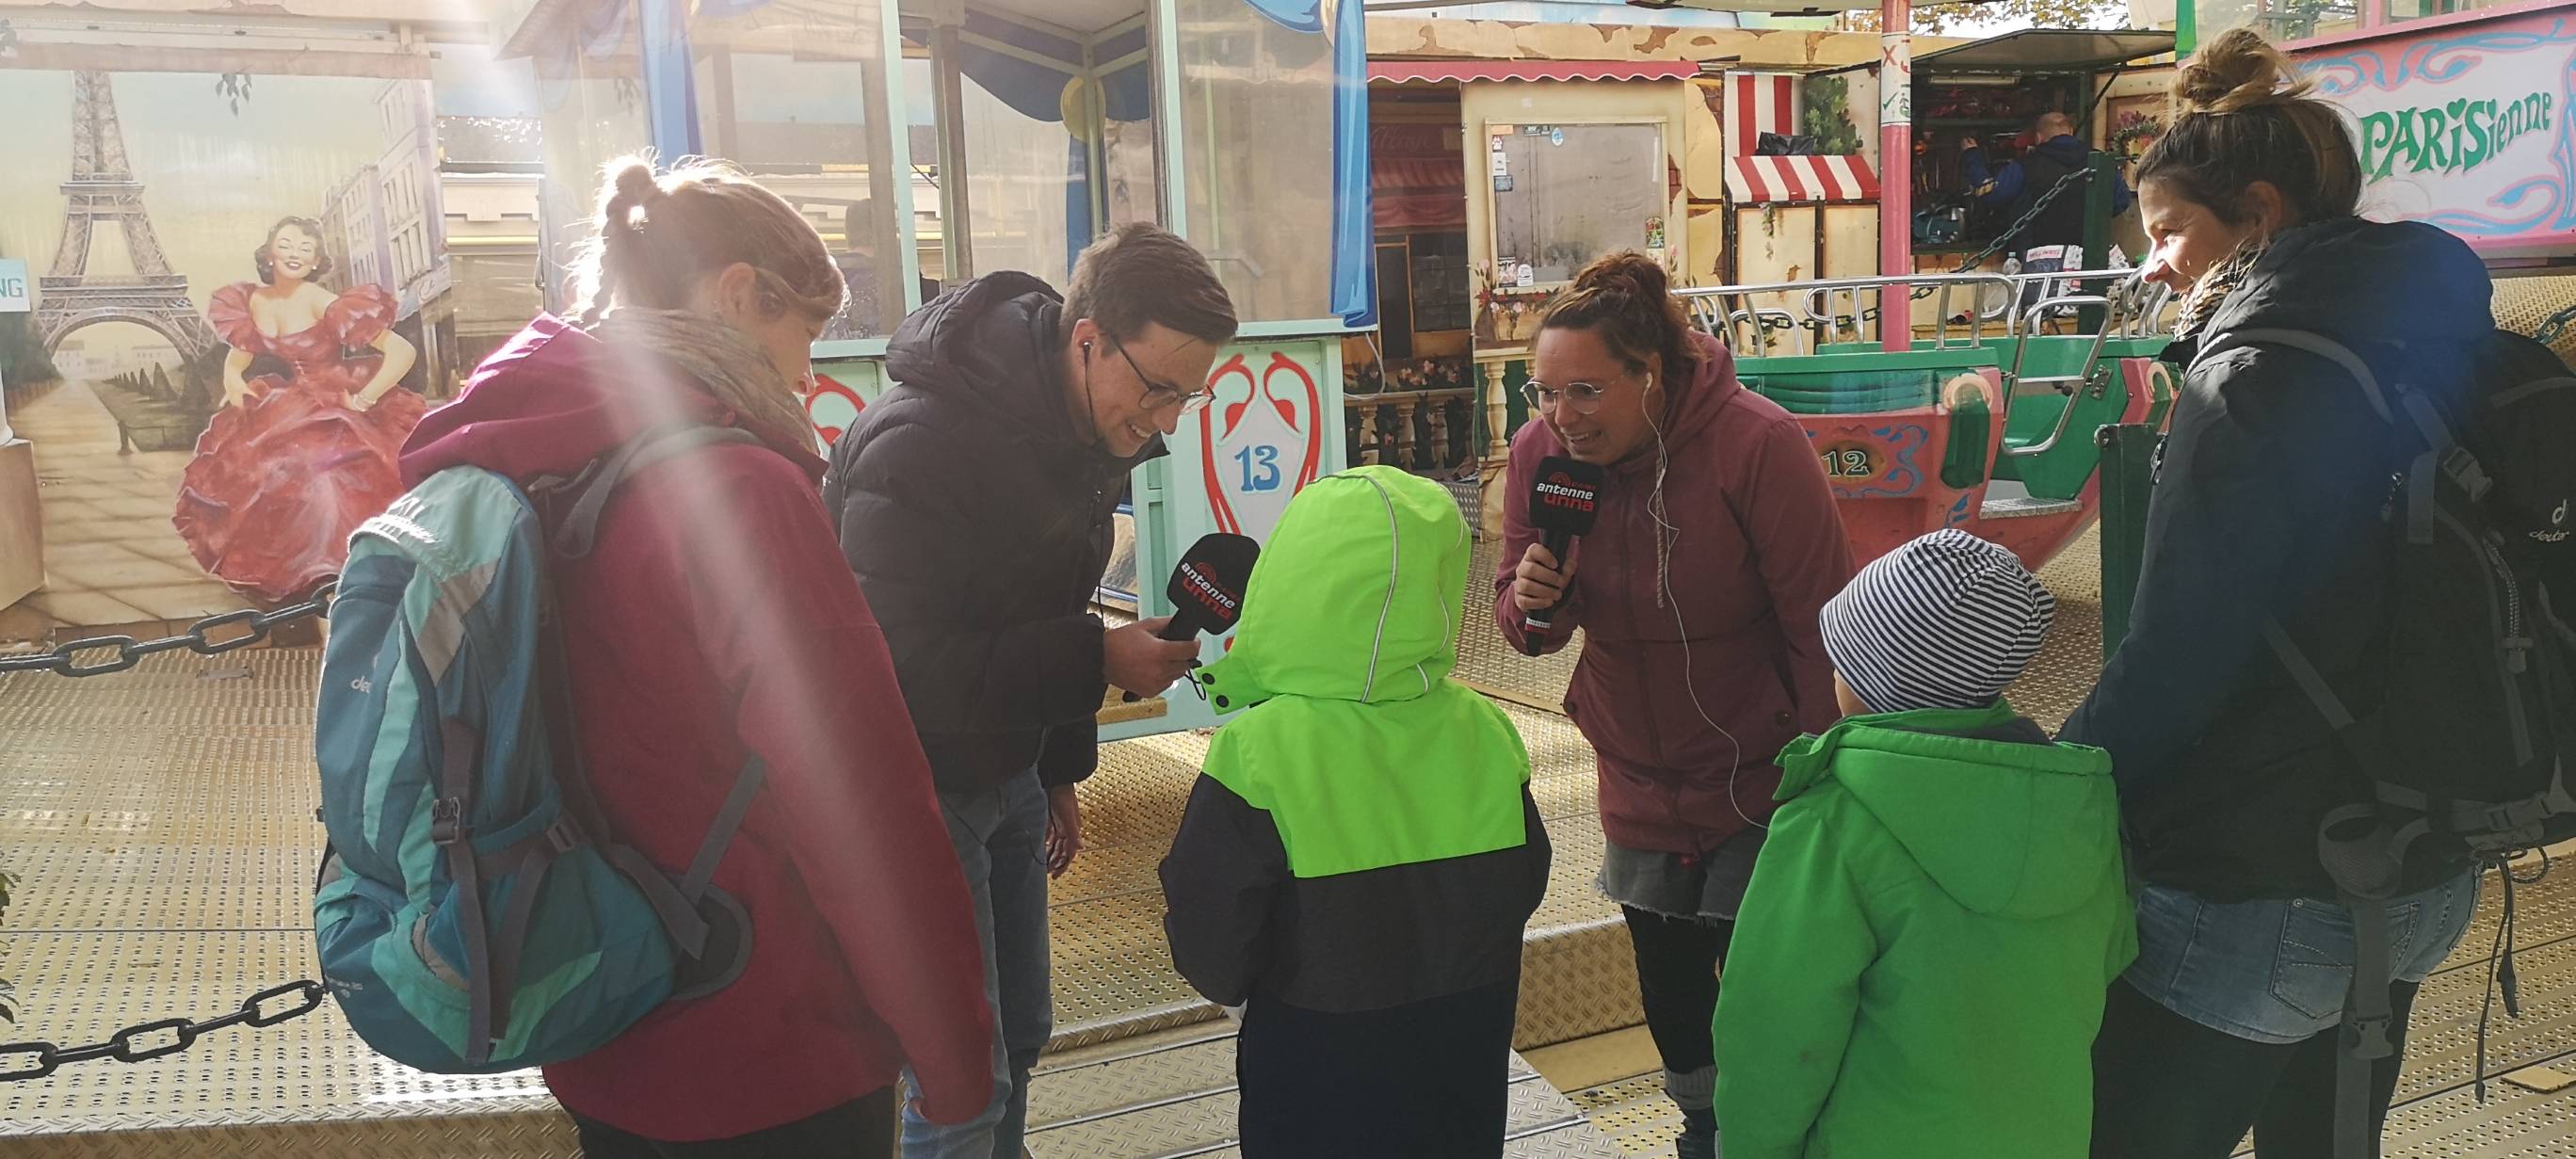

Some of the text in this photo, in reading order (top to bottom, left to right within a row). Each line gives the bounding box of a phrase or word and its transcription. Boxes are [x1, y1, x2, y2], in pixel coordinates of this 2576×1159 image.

[1234, 444, 1280, 491] 13
[1821, 451, 1870, 477] 12
[1536, 482, 1594, 501] antenne
[1181, 562, 1236, 609] antenne
